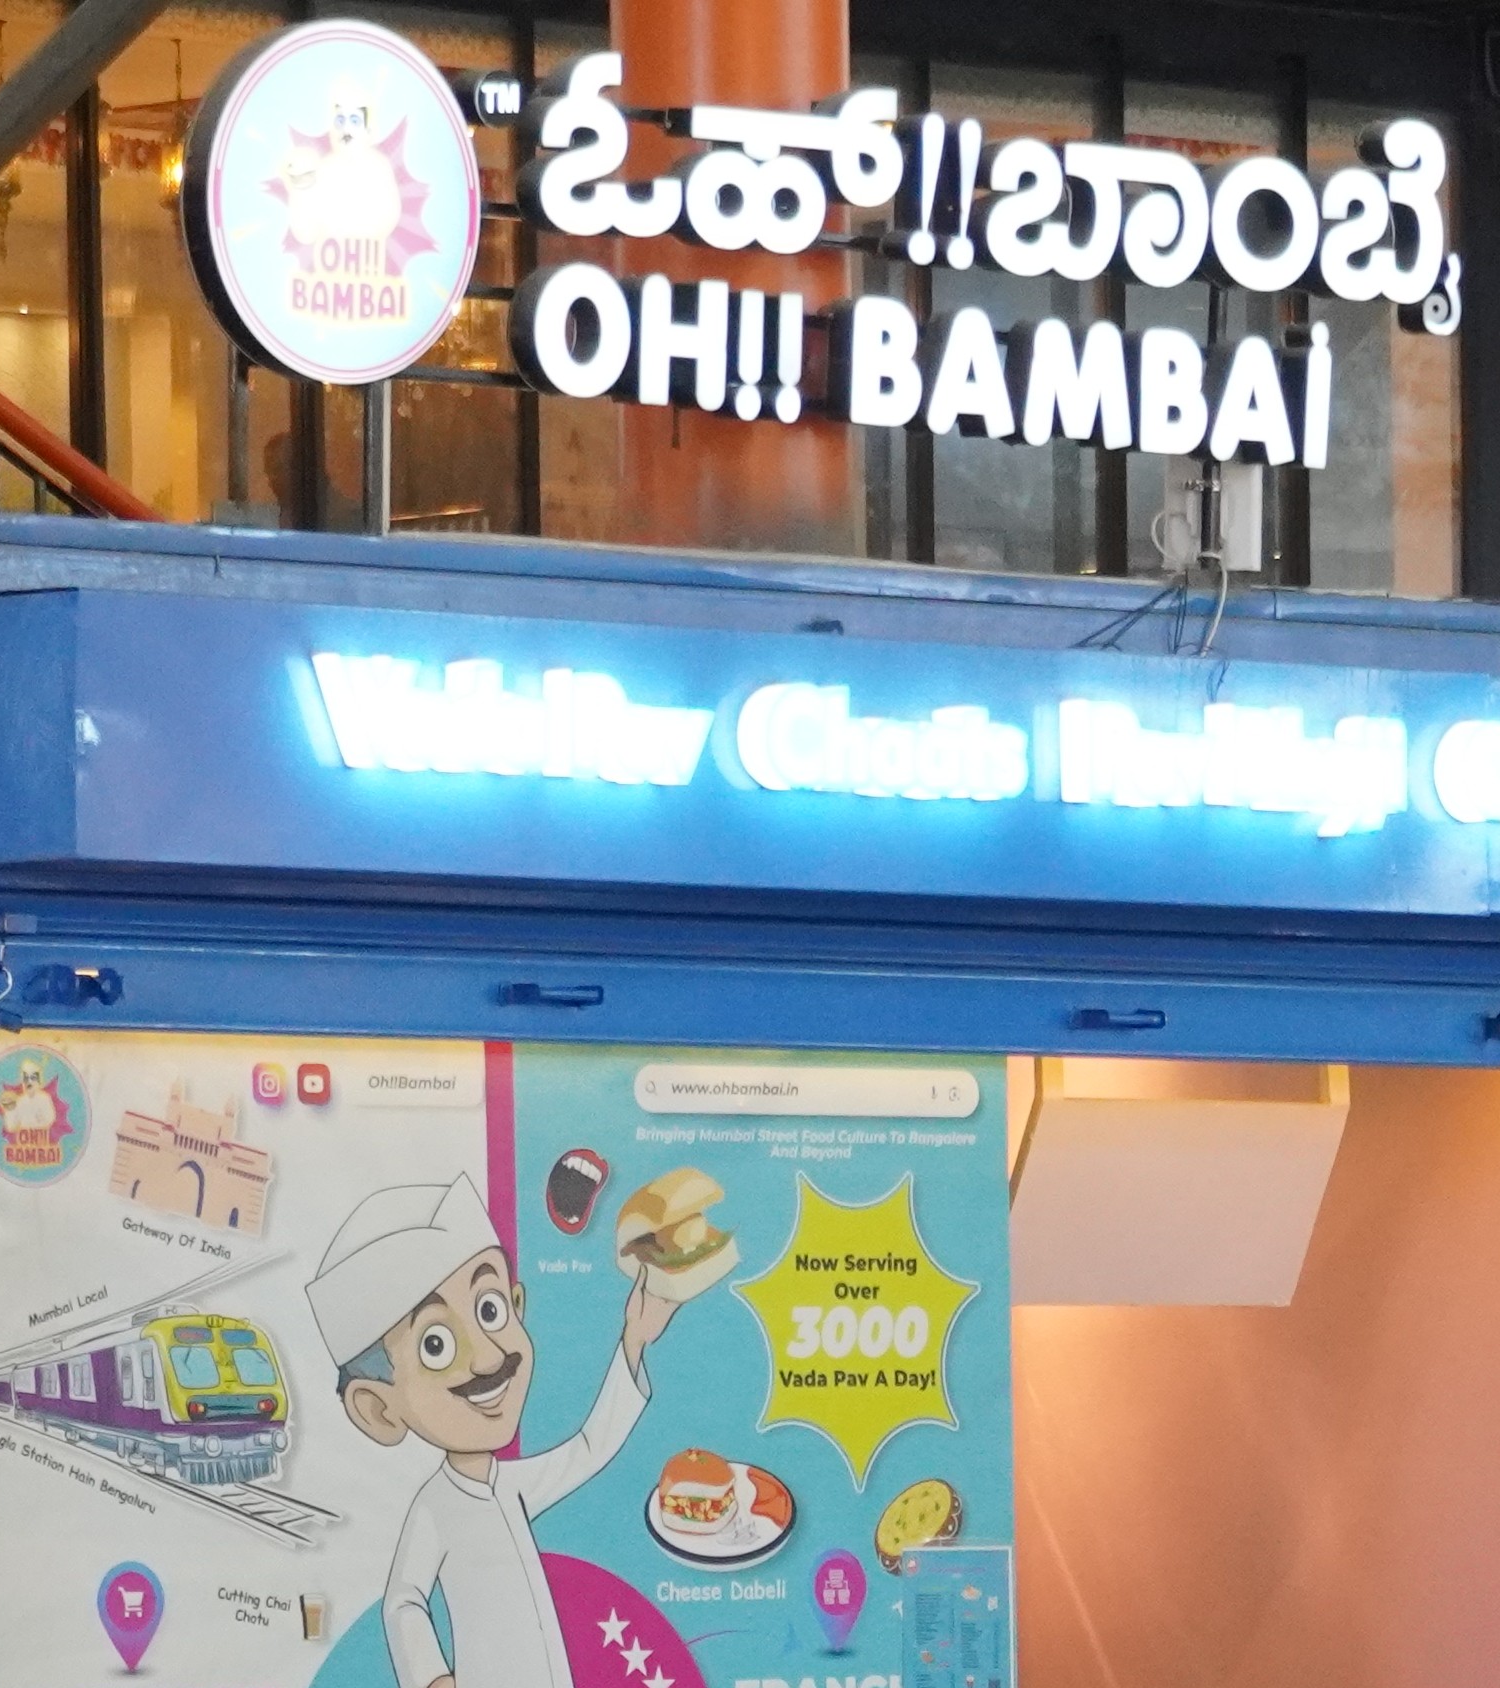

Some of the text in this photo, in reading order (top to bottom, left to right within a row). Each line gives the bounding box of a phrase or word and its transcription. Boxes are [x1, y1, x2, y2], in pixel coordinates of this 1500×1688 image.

[309, 238, 382, 280] OH!!
[290, 276, 408, 320] BAMBAI
[532, 262, 804, 424] OH!!
[367, 1074, 457, 1092] Oh!!Bambai
[671, 1081, 800, 1098] www.ohbambai.in
[121, 1216, 232, 1260] Gateway Of India
[795, 1254, 918, 1277] Now Serving
[77, 1286, 109, 1310] Local
[834, 1282, 880, 1301] Over
[786, 1305, 930, 1360] 3000
[779, 1369, 937, 1392] Vada Pav A Day!
[20, 1443, 65, 1476] Station
[69, 1464, 96, 1488] Hain
[99, 1478, 157, 1515] Bengaluru
[216, 1586, 292, 1612] Cutting Chai
[656, 1579, 787, 1602] Cheese Dabeli
[234, 1609, 271, 1628] Chotu
